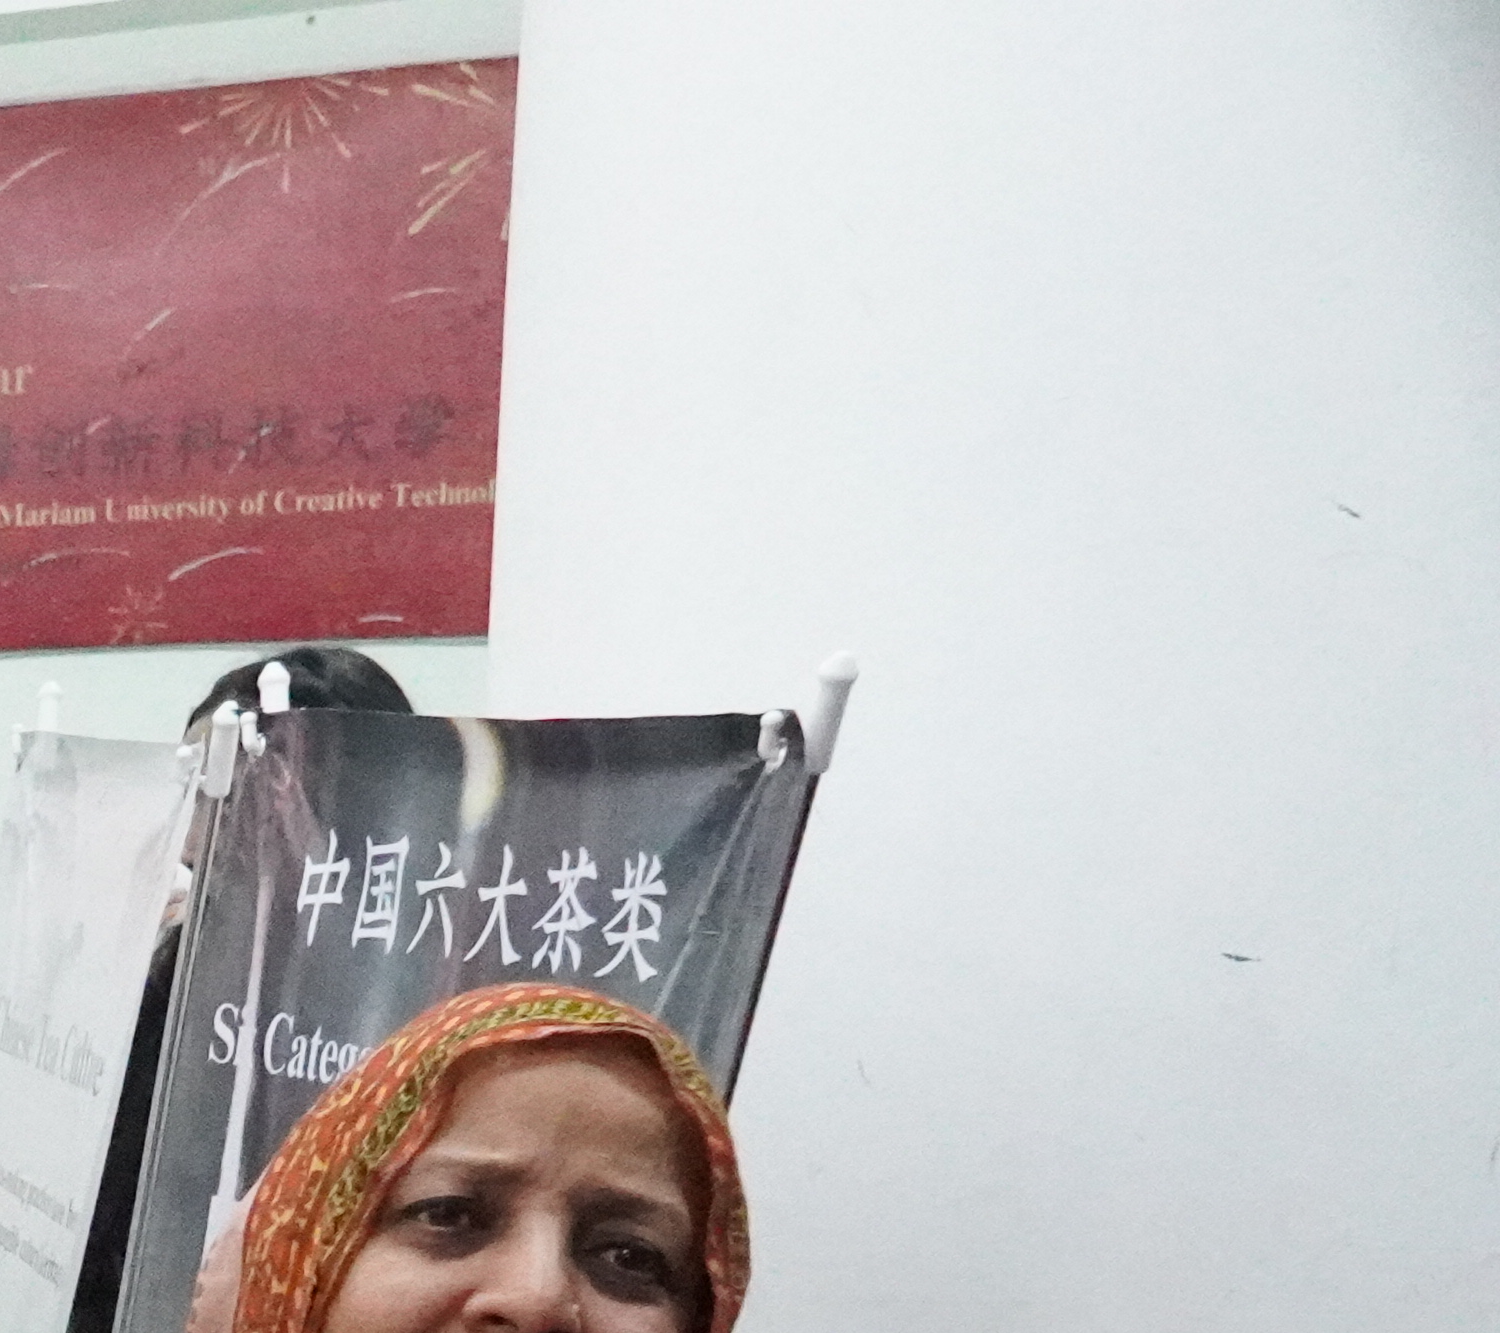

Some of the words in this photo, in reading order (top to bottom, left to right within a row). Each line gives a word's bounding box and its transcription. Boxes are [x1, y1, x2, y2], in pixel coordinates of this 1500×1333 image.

[104, 492, 230, 526] University
[239, 488, 269, 517] of
[273, 482, 383, 516] Creative
[390, 477, 495, 509] Technol
[297, 828, 668, 983] 中国六大茶类
